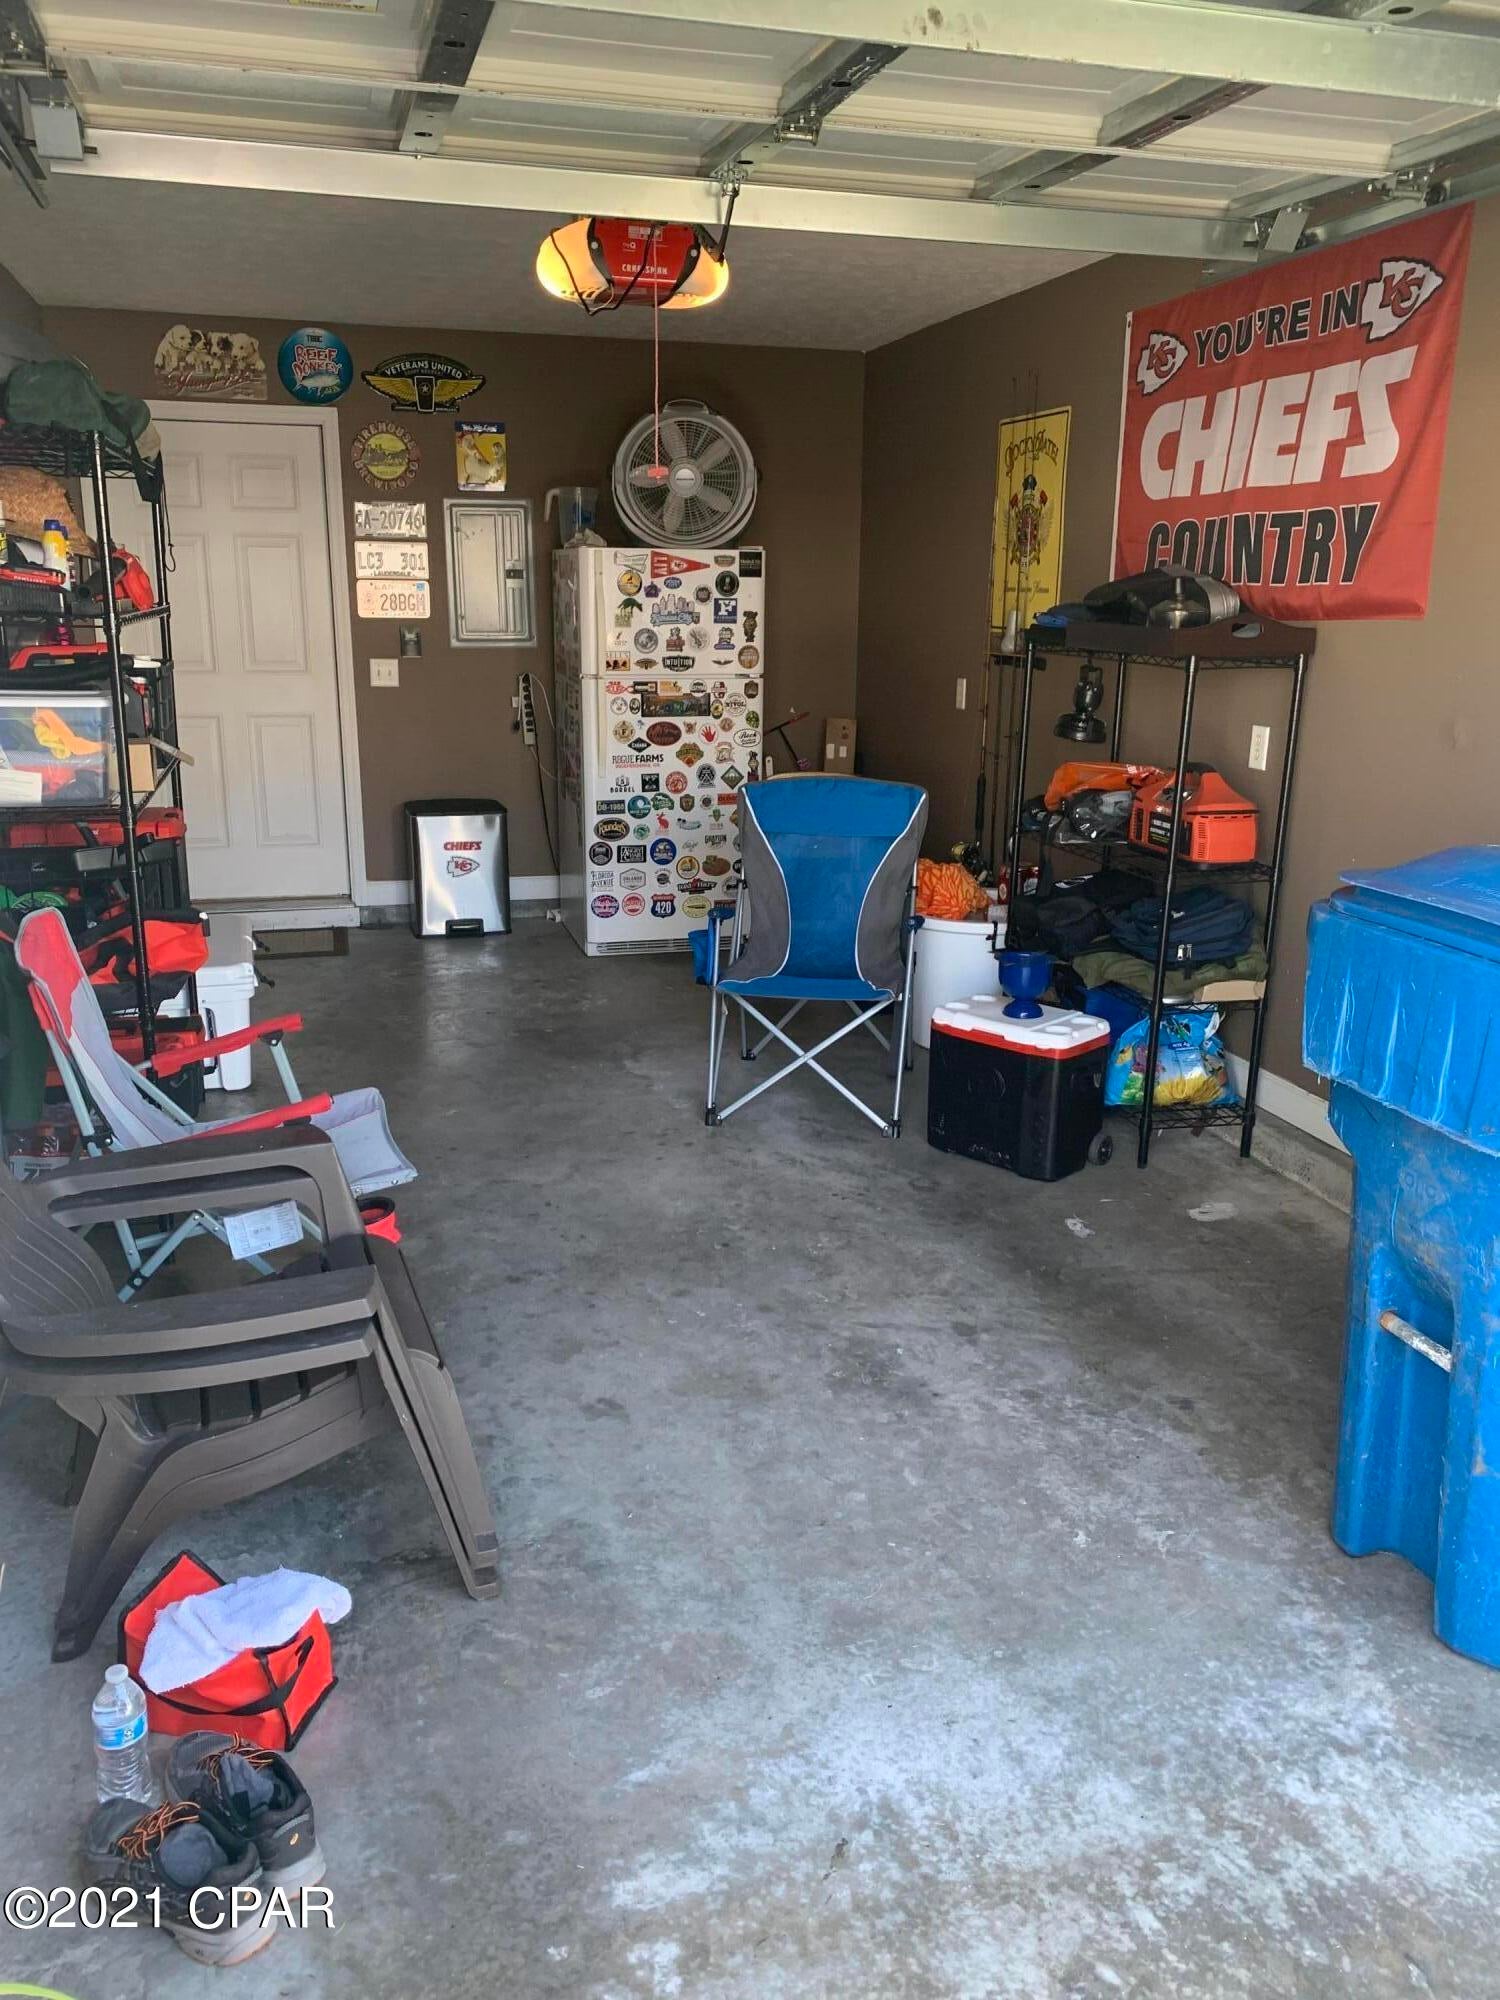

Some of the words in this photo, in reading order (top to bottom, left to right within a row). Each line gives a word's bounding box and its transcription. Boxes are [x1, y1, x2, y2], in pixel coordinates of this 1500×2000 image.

[621, 264, 668, 275] CRAFSMAN
[1193, 297, 1312, 367] YOU'RE
[1319, 281, 1362, 336] IN
[295, 344, 338, 362] REEF
[292, 361, 342, 377] DONKEY
[385, 360, 429, 377] VETERANS
[430, 361, 464, 380] UNITED
[1139, 344, 1419, 500] CHIEFS
[1143, 502, 1380, 587] COUNTRY
[635, 753, 665, 763] FARMS
[443, 841, 483, 851] CHIEFS
[655, 901, 672, 914] 420
